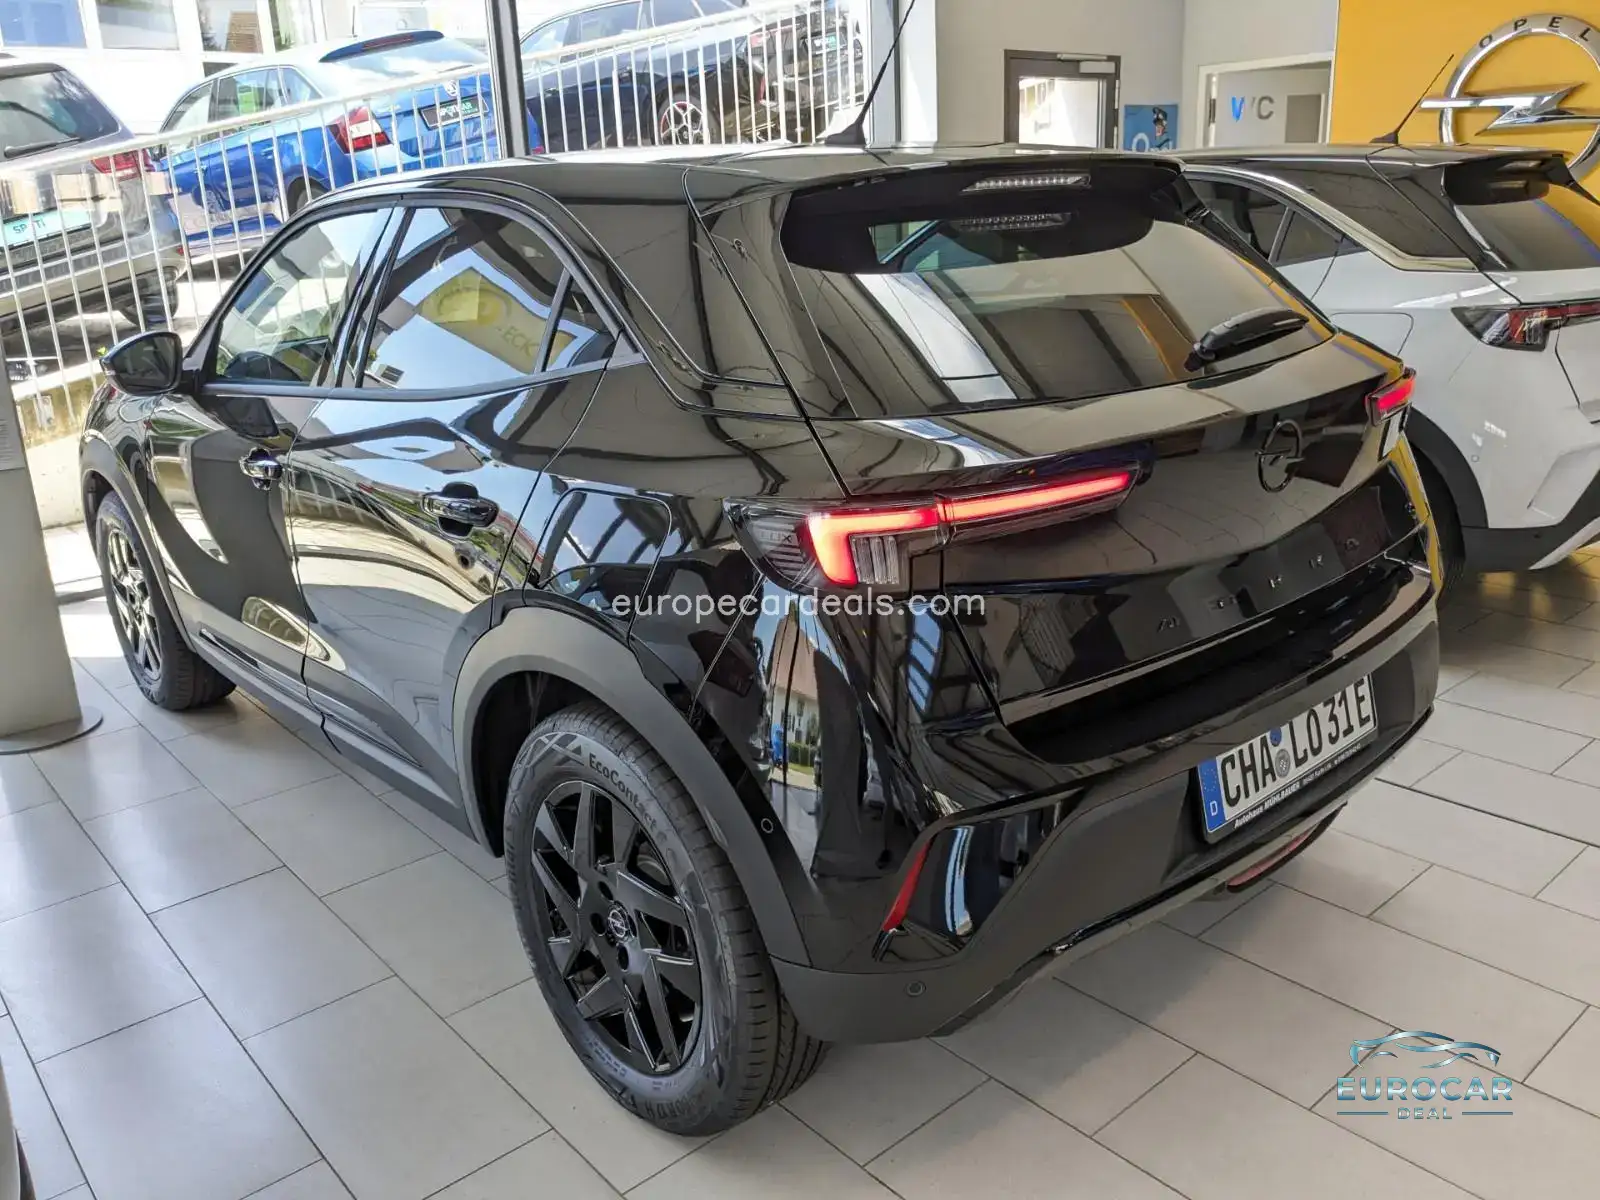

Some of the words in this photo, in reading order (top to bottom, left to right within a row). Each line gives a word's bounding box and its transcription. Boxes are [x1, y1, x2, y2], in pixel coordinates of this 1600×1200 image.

[1478, 16, 1592, 49] OPEL
[1220, 734, 1277, 808] CHA
[1288, 708, 1323, 769] LO
[588, 752, 658, 833] EcoContact
[1209, 800, 1219, 817] D
[1233, 805, 1264, 830] Autohaus
